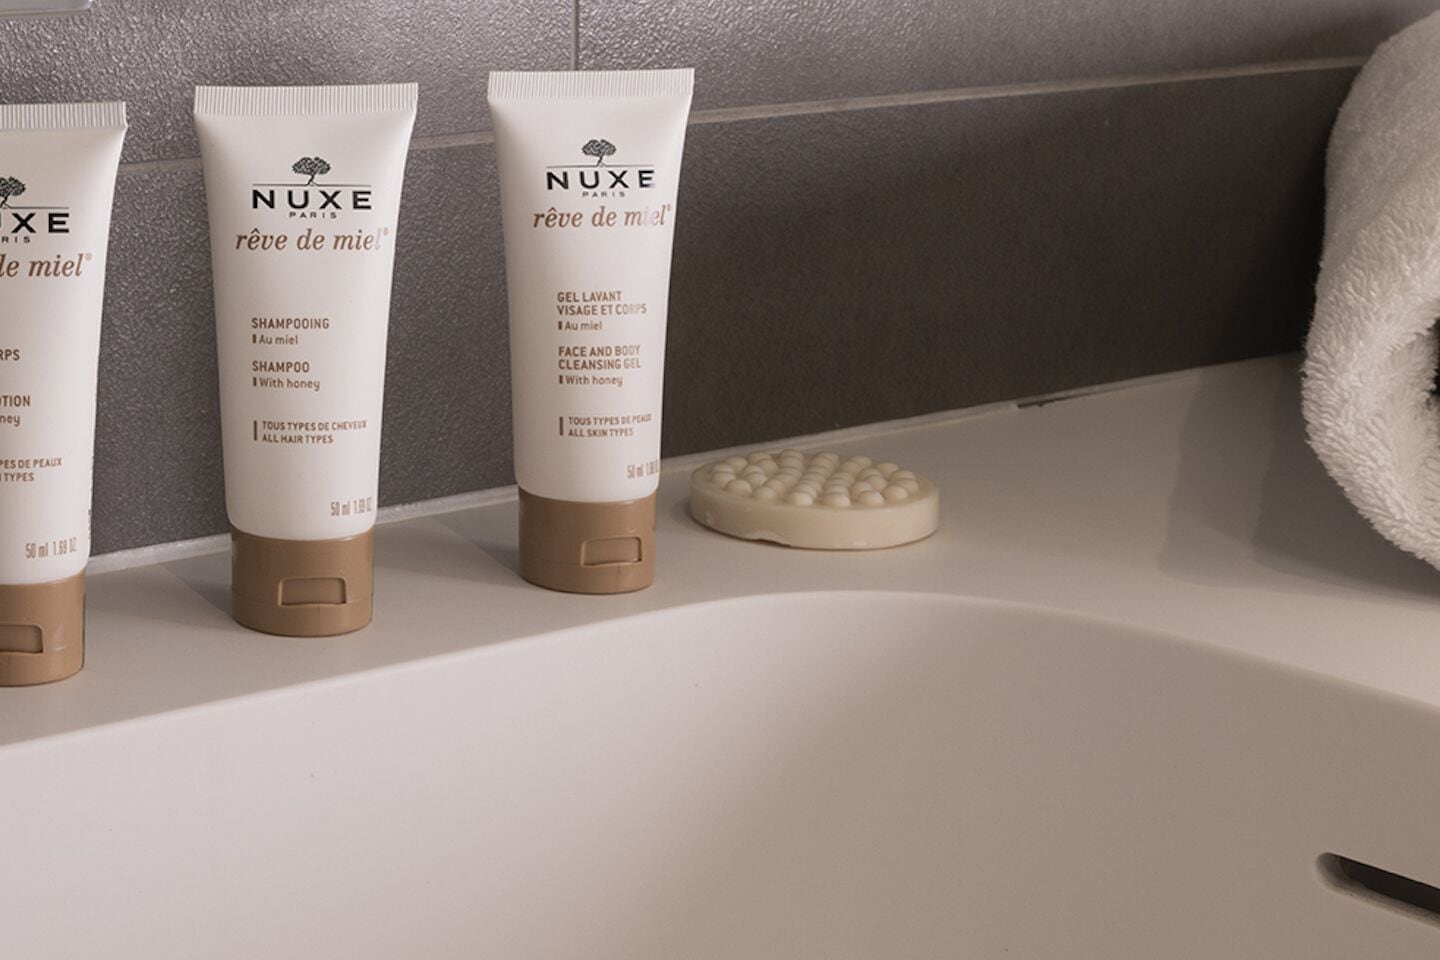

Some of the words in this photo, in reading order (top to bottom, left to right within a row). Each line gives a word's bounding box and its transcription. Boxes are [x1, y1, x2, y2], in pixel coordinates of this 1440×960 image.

[546, 170, 655, 190] NUXE
[252, 190, 372, 210] NUXE
[533, 207, 583, 228] rêve
[591, 206, 617, 227] de
[235, 228, 287, 250] rêve
[296, 228, 325, 250] de
[557, 292, 580, 303] GEL
[582, 291, 622, 302] LAVANT
[557, 305, 597, 316] VISAGE
[600, 305, 613, 315] ET
[615, 304, 647, 315] CORPS
[251, 317, 330, 329] SHAMPOOING
[564, 322, 579, 330] Au
[581, 321, 602, 331] miel
[259, 335, 273, 345] Au
[275, 334, 298, 345] miel
[558, 346, 586, 357] FACE
[589, 346, 613, 357] AND
[615, 345, 641, 356] BODY
[252, 361, 309, 372] SHAMPOO
[558, 359, 622, 370] CLEANSING
[624, 359, 641, 369] GEL
[259, 377, 284, 388] With
[286, 378, 320, 392] honey
[566, 375, 589, 385] With
[592, 375, 623, 387] honey
[262, 421, 285, 431] TOUS
[287, 422, 317, 431] TYPES
[318, 422, 329, 431] DE
[332, 420, 368, 431] CHEVEUX
[568, 417, 591, 426] TOUS
[592, 416, 619, 425] TYPES
[621, 416, 630, 425] DE
[568, 428, 584, 437] ALL
[587, 428, 607, 438] SKIN
[607, 427, 633, 437] TYPES
[261, 435, 279, 443] ALL
[280, 435, 304, 444] HAIR
[305, 435, 334, 444] TYPES
[18, 459, 31, 468] DE
[32, 458, 62, 468] PEAUX
[3, 473, 34, 482] TYPES
[25, 542, 36, 559] 50
